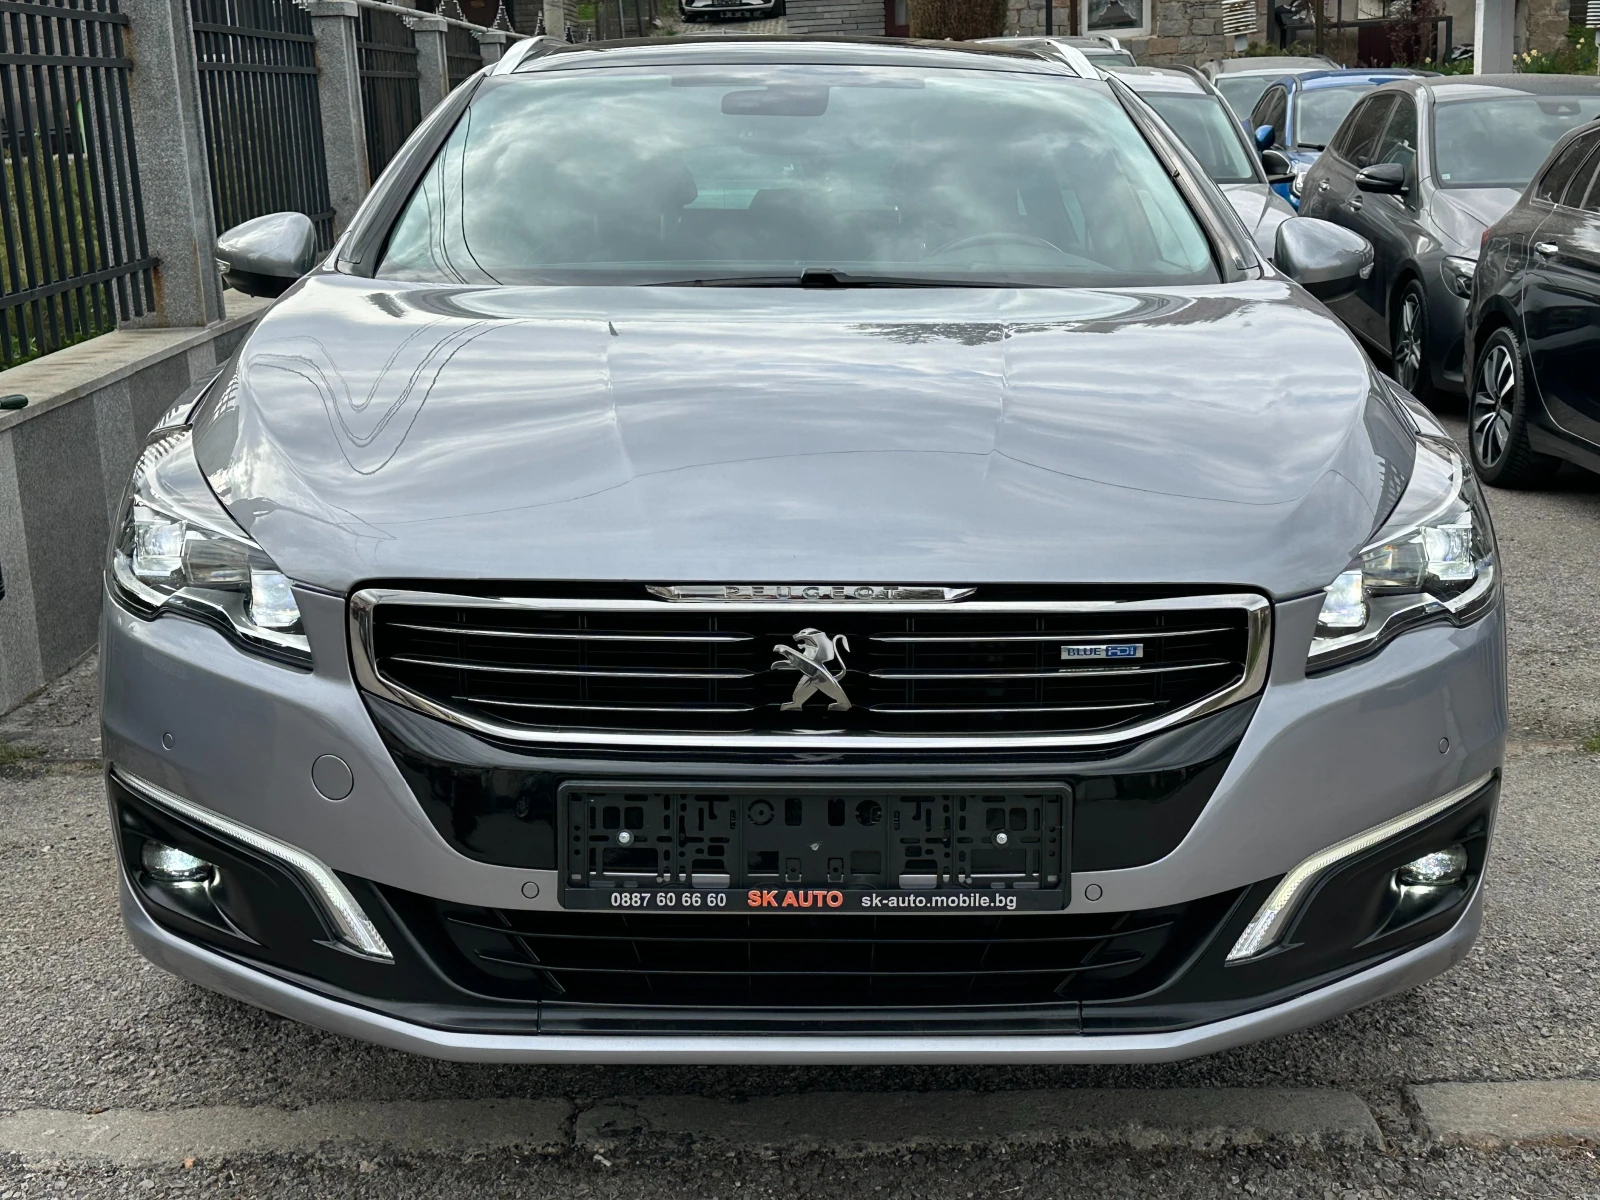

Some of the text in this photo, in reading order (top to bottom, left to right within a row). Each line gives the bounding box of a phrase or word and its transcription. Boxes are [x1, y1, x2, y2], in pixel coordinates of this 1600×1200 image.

[724, 585, 899, 600] PEUGEOT
[1067, 647, 1102, 656] BLUE
[611, 892, 727, 907] 0887 60 66 60
[747, 890, 844, 908] SK AUTO
[861, 893, 1018, 910] sk-auto.mobile.bg
